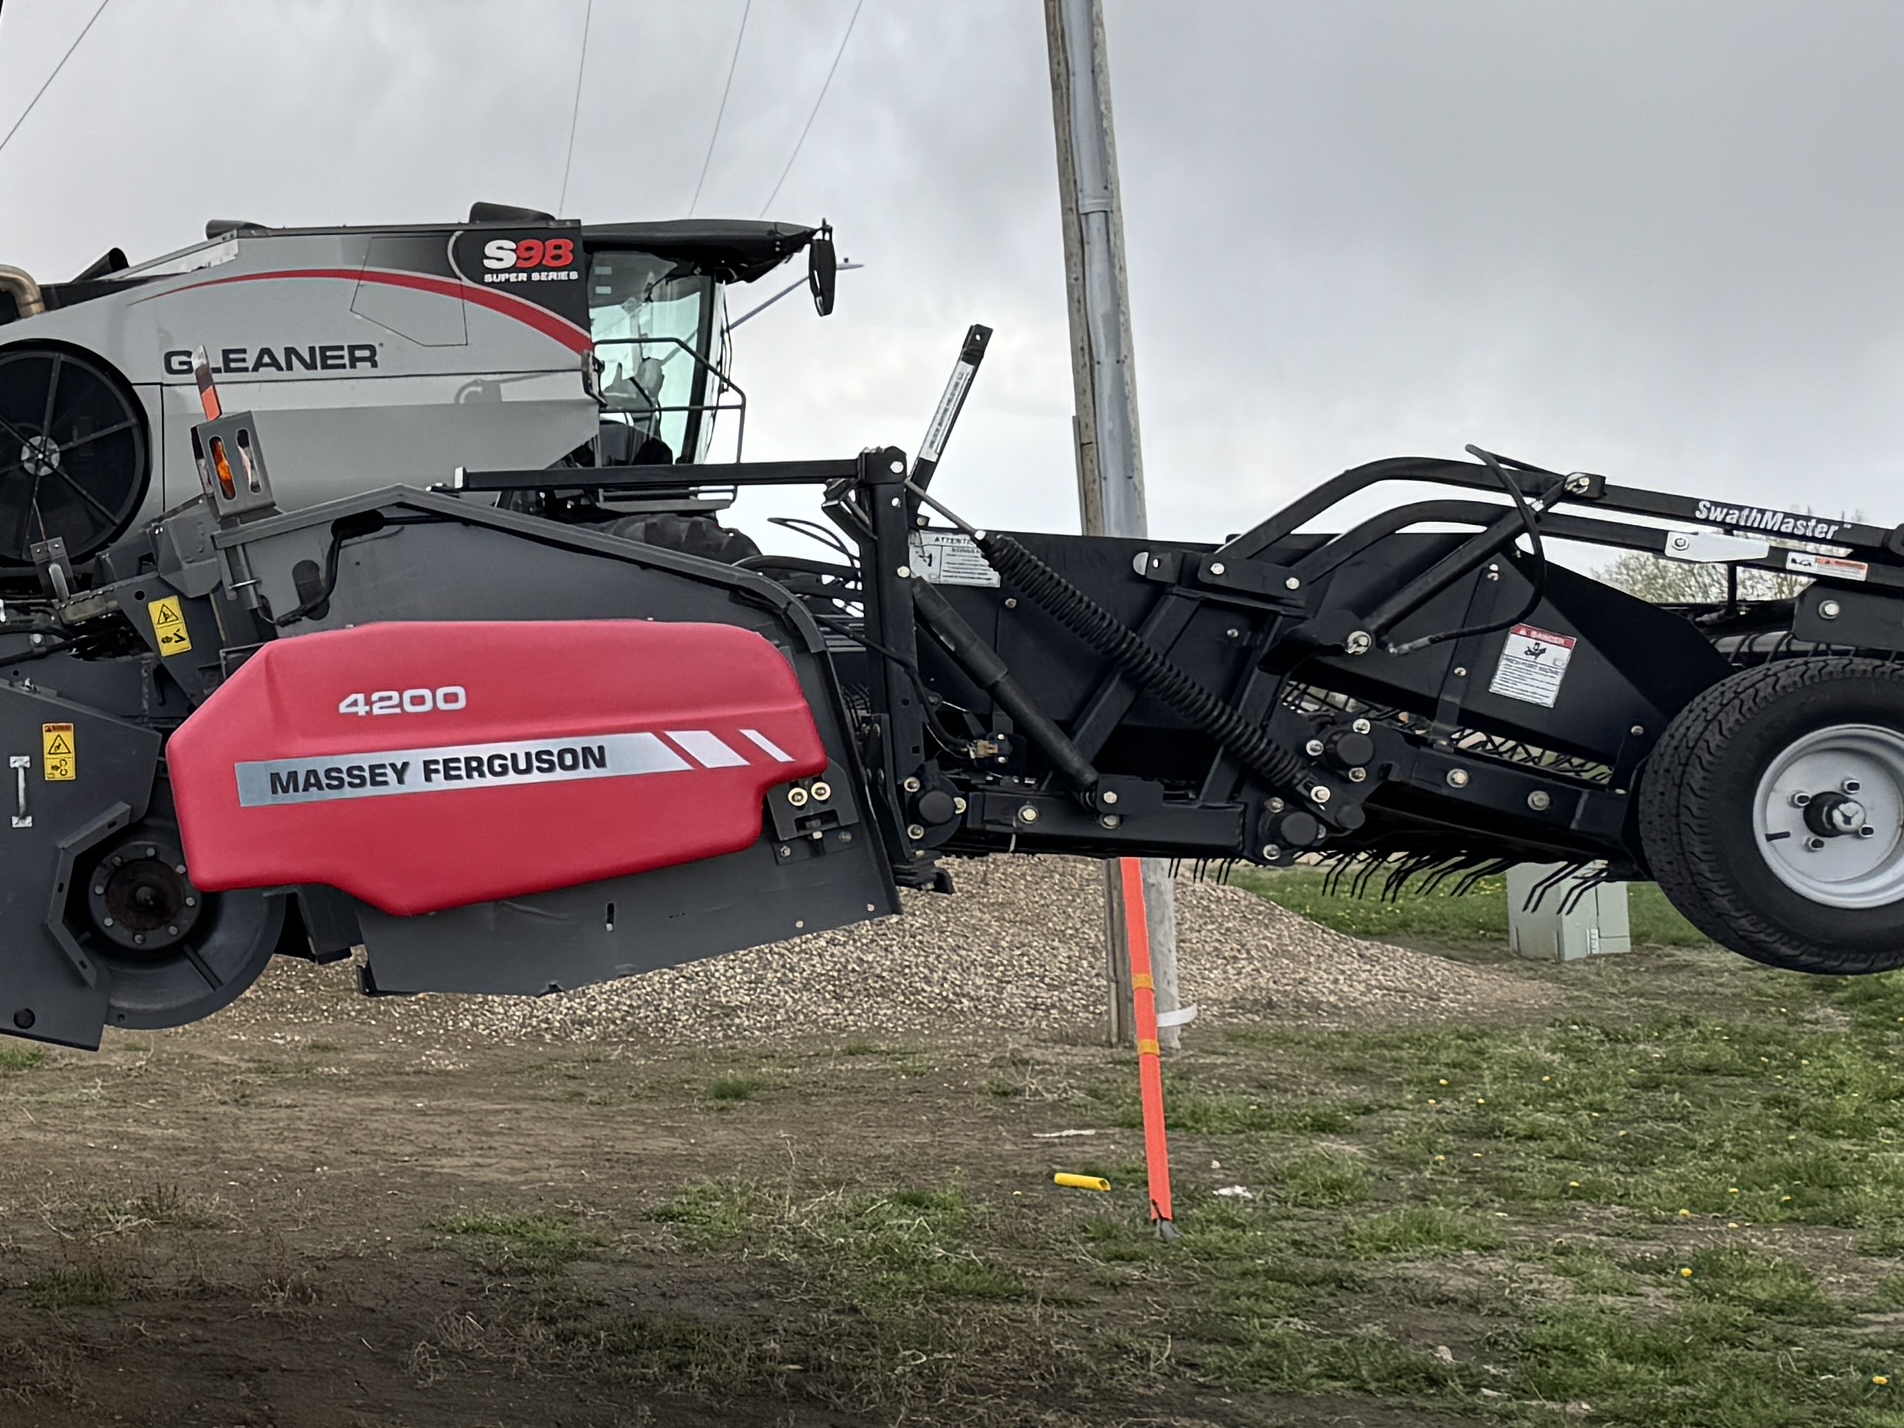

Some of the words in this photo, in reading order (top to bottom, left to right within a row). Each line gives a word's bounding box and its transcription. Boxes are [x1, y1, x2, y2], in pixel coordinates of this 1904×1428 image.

[483, 238, 575, 270] S98
[484, 273, 528, 283] SUPER
[531, 271, 579, 281] SERIES
[1695, 500, 1840, 540] SwathMaster
[338, 686, 467, 716] 4200
[269, 762, 410, 795] MASSEY
[422, 745, 607, 783] FERGUSON
